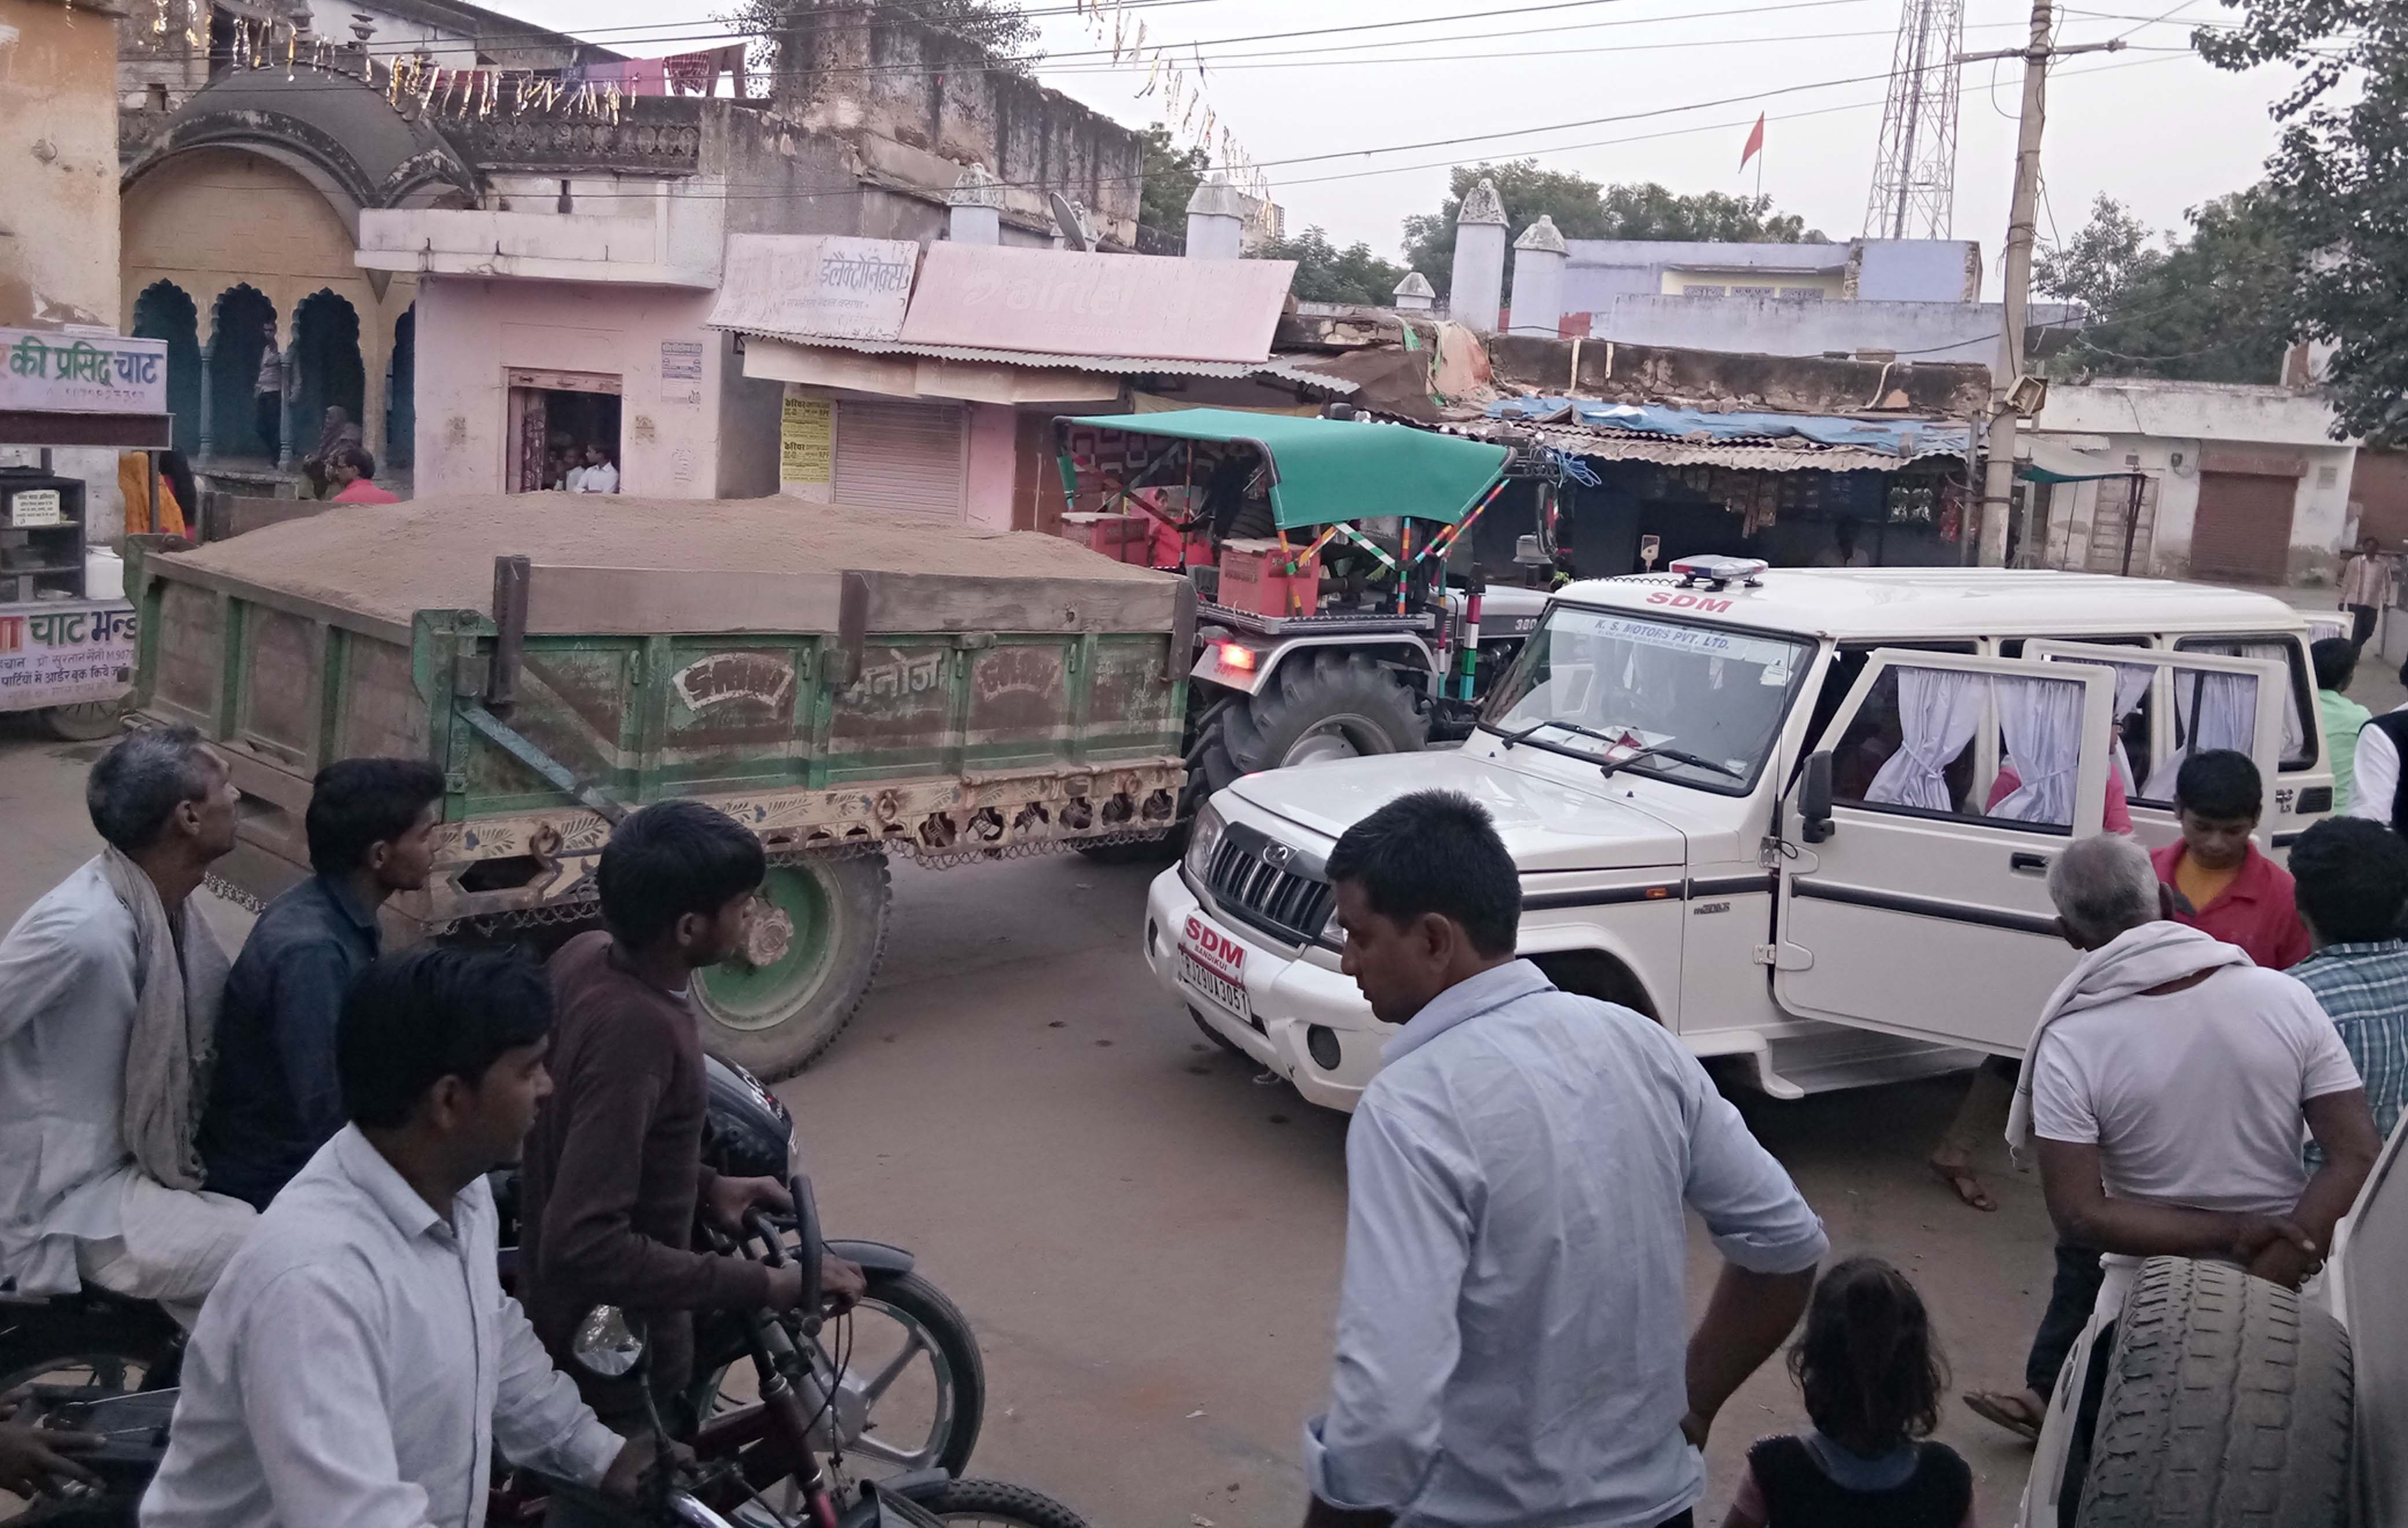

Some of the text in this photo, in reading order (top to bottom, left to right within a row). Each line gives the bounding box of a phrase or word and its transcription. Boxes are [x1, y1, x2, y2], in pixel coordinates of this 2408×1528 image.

[10, 336, 52, 378] की
[114, 351, 163, 384] चाट
[1646, 592, 1733, 613] SDM
[29, 612, 87, 647] चाट
[91, 609, 136, 642] भन्ड
[1623, 623, 1671, 639] MOTORS
[1672, 631, 1698, 645] PVT.
[1702, 637, 1730, 650] LTD.
[1186, 916, 1245, 969] SDM
